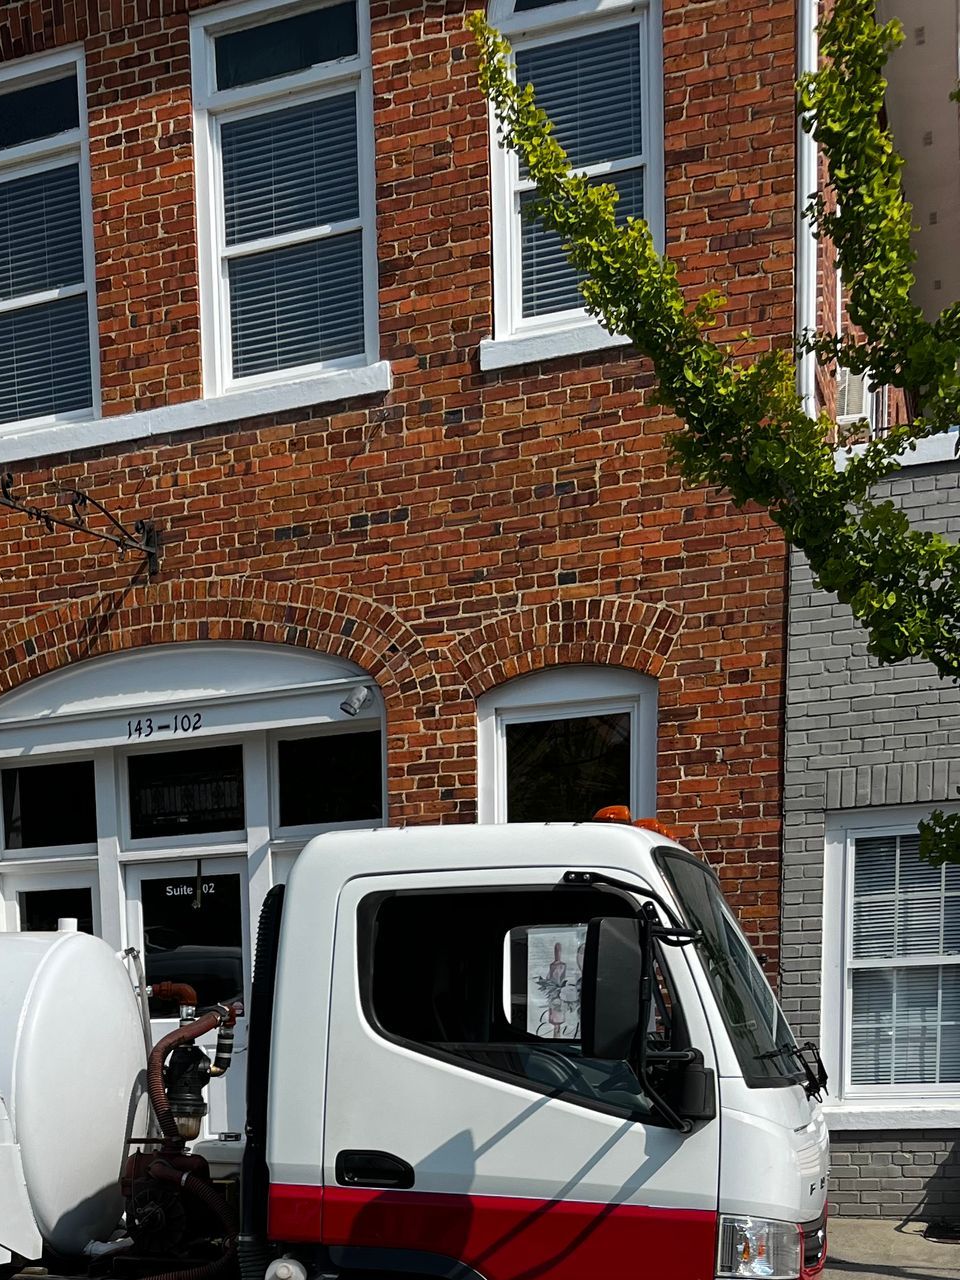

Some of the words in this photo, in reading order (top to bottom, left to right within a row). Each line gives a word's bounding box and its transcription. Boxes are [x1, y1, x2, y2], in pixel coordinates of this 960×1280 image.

[127, 712, 202, 740] 143-102
[166, 884, 194, 896] Suite
[198, 882, 215, 894] 02
